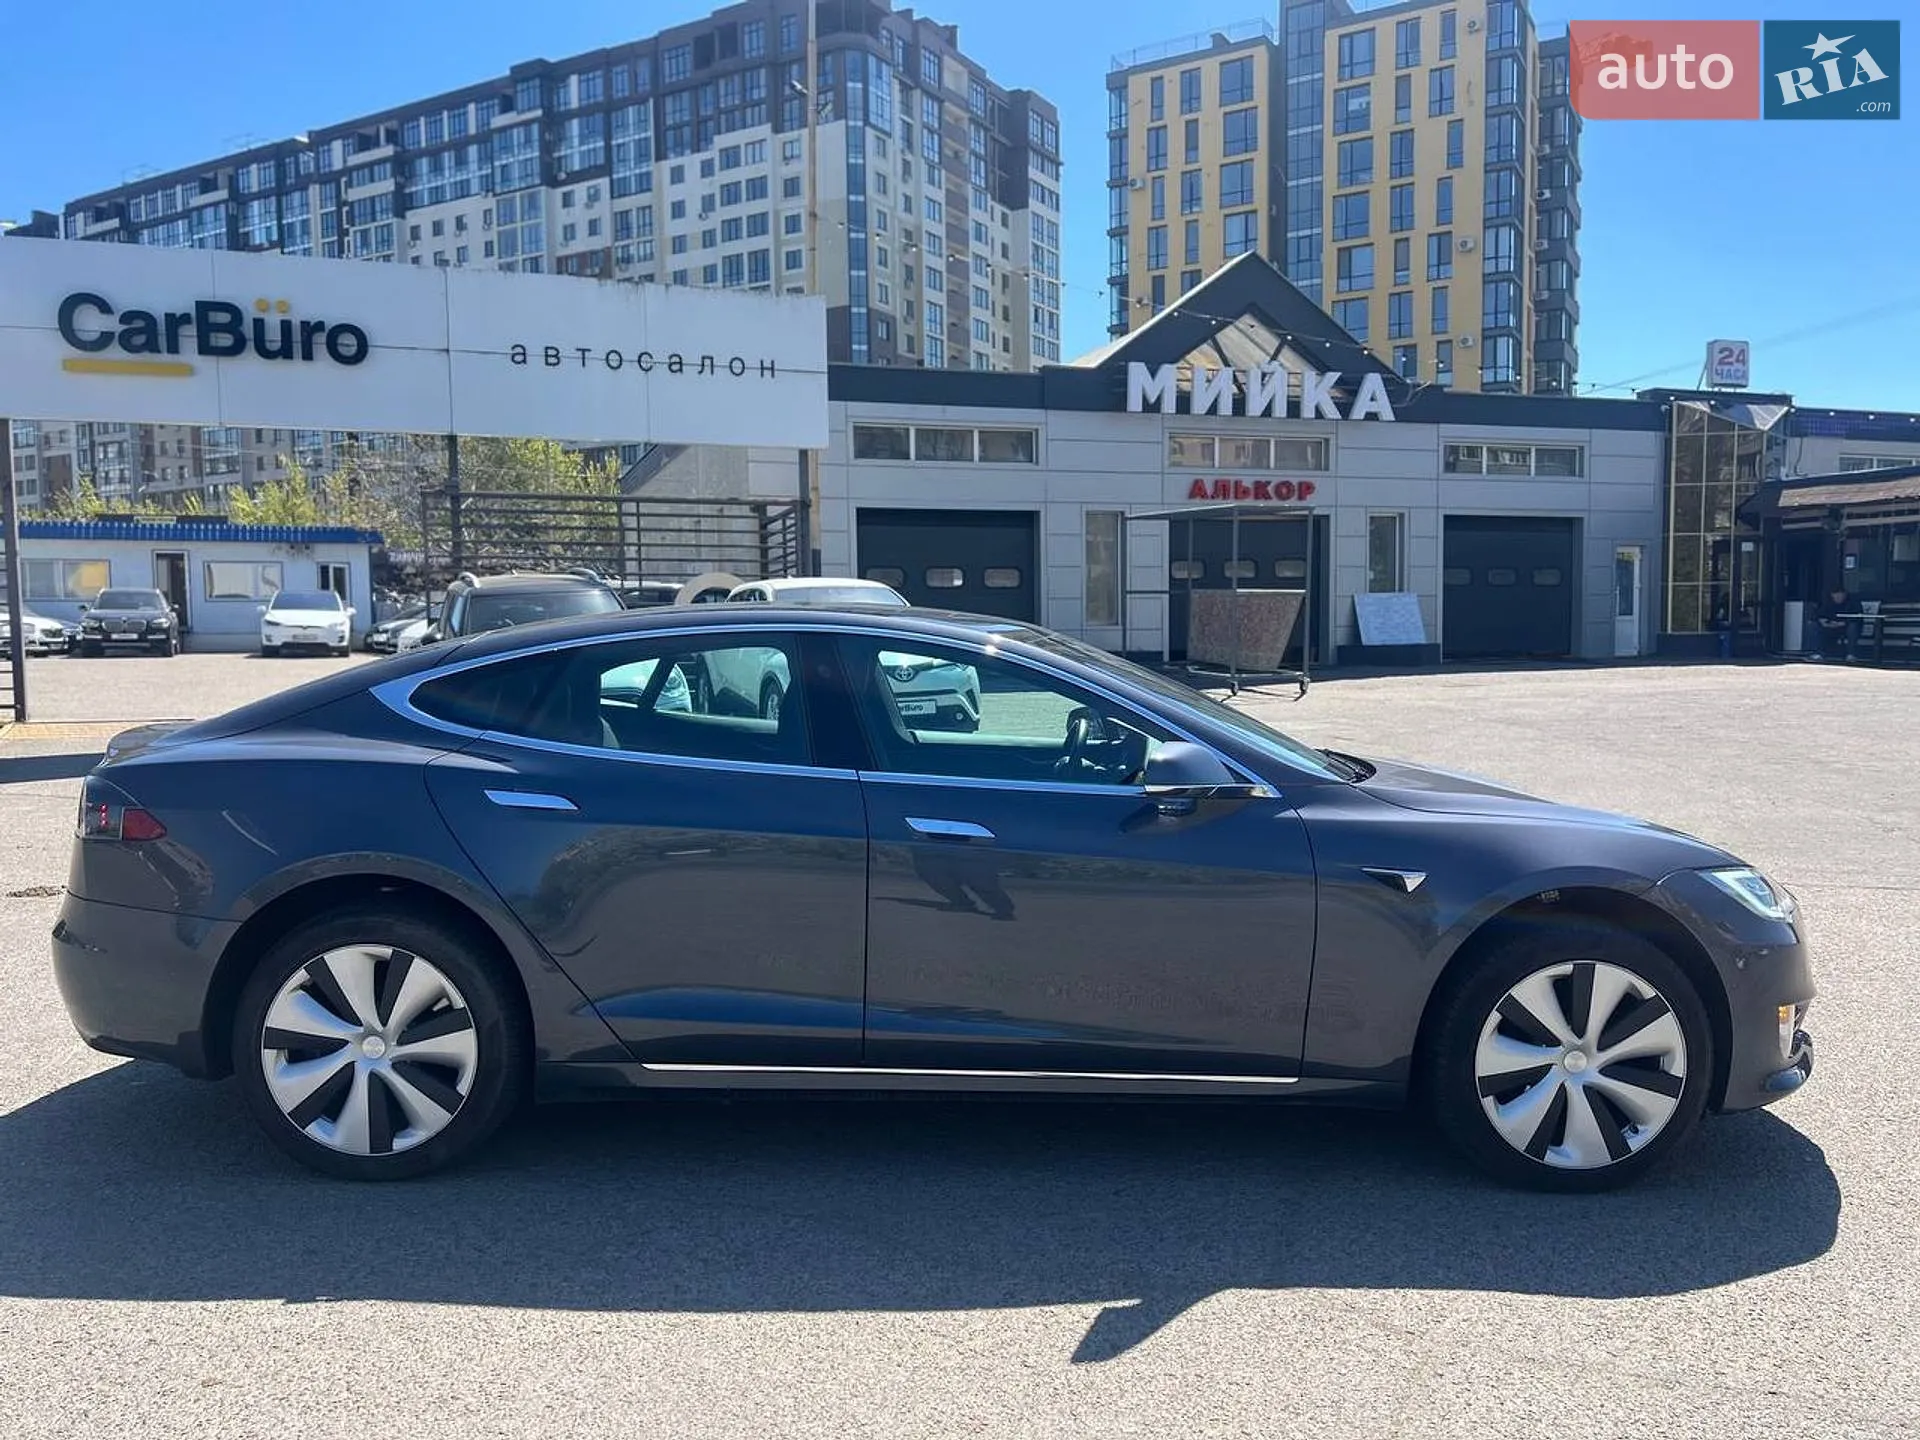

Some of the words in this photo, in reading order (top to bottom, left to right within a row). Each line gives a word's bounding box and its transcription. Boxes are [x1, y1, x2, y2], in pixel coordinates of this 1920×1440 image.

[57, 292, 369, 366] CarBüro
[510, 343, 775, 379] автосалон
[1717, 346, 1746, 366] 24
[1126, 360, 1396, 421] МИЙКА
[1188, 478, 1317, 501] АЛЬКОР
